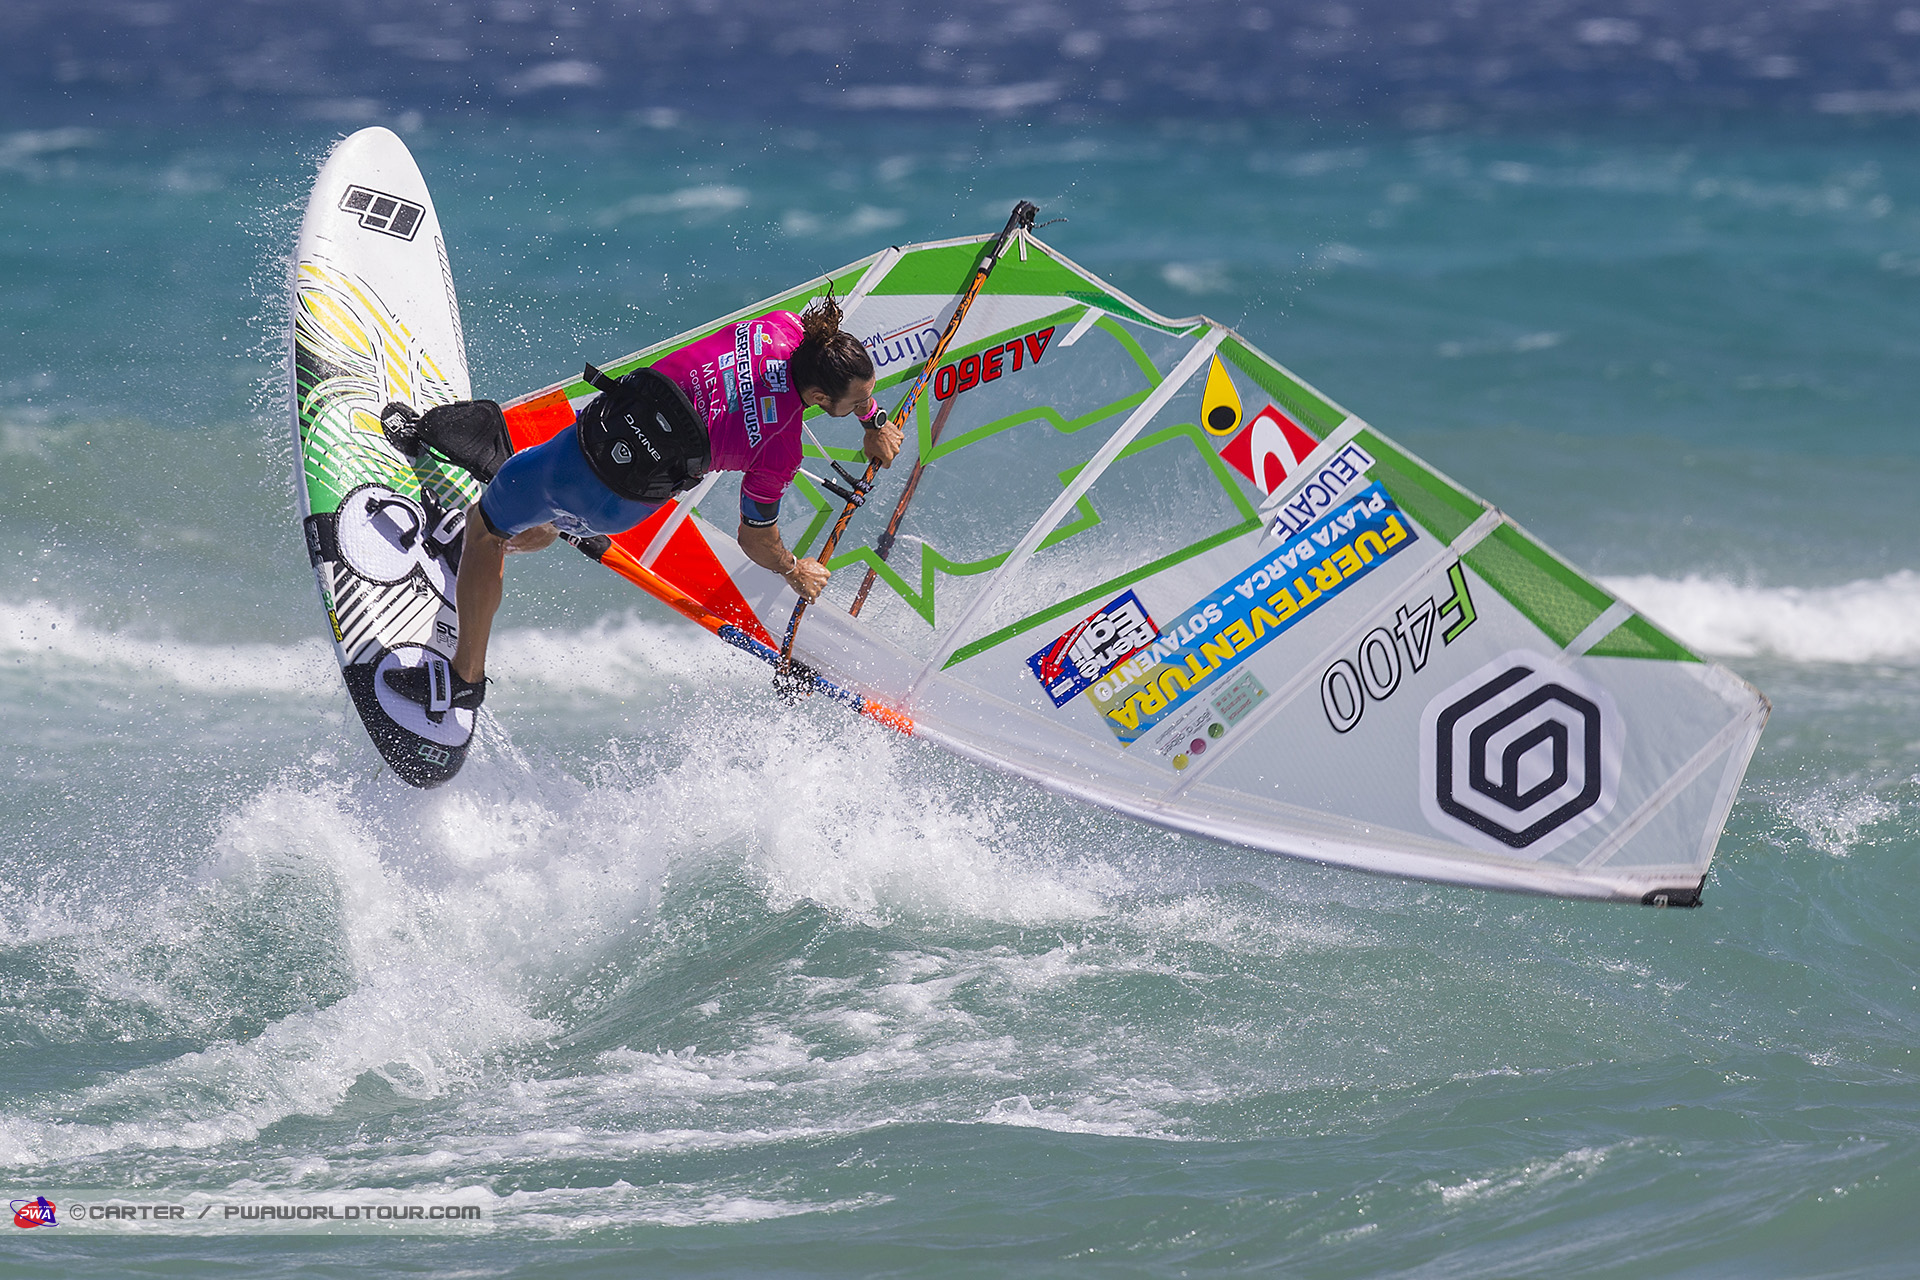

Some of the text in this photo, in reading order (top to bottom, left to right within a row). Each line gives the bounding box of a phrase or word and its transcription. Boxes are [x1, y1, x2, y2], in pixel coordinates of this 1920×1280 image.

[764, 360, 781, 393] Egli
[934, 326, 1056, 402] AL360
[623, 413, 661, 463] DAKINE
[1271, 443, 1369, 541] LEUCATE
[1311, 490, 1388, 549] PLAYA
[1234, 541, 1318, 601] BARCA
[1067, 599, 1148, 669] Egli
[1079, 620, 1159, 683] René
[1093, 602, 1225, 704] SOTAVENTO
[1107, 514, 1409, 733] FUERTEVENTURA
[1320, 558, 1479, 735] F400
